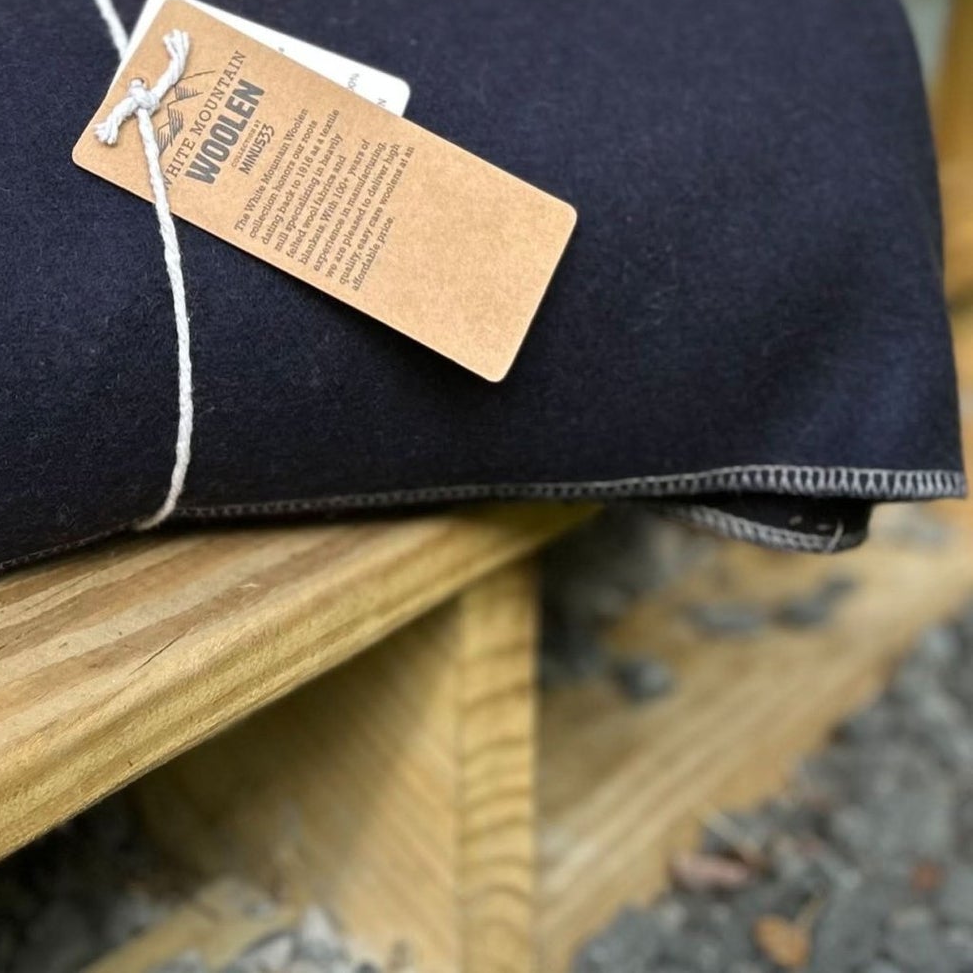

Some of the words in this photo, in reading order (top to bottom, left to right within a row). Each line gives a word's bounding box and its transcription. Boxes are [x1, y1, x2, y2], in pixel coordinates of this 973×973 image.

[185, 78, 265, 185] WOOLEN
[190, 51, 245, 135] MOUNTAIN
[234, 213, 250, 231] The
[244, 185, 266, 212] White
[261, 143, 290, 184] Mountain
[283, 109, 308, 141] Woolen
[239, 124, 275, 174] MINUS33
[249, 193, 278, 238] collection
[272, 160, 295, 192] honors
[292, 143, 305, 160] our
[301, 120, 318, 143] roots
[261, 214, 284, 245] dating
[277, 190, 295, 214] back
[320, 109, 340, 137] textile
[274, 232, 289, 252] mill
[285, 177, 320, 232] specializing
[319, 133, 343, 166] heavily
[320, 200, 338, 222] With
[333, 177, 349, 199] 100+
[347, 151, 365, 176] years
[286, 229, 307, 258] felted
[302, 205, 319, 229] wool
[313, 174, 336, 206] fabrics
[333, 154, 347, 174] and
[313, 218, 345, 271] experience
[334, 246, 347, 263] are
[342, 208, 366, 247] pleased
[367, 165, 388, 197] deliver
[383, 144, 400, 165] high
[357, 227, 373, 250] easy
[368, 207, 383, 228] care
[379, 168, 403, 205] woolens
[352, 244, 380, 291] affordable
